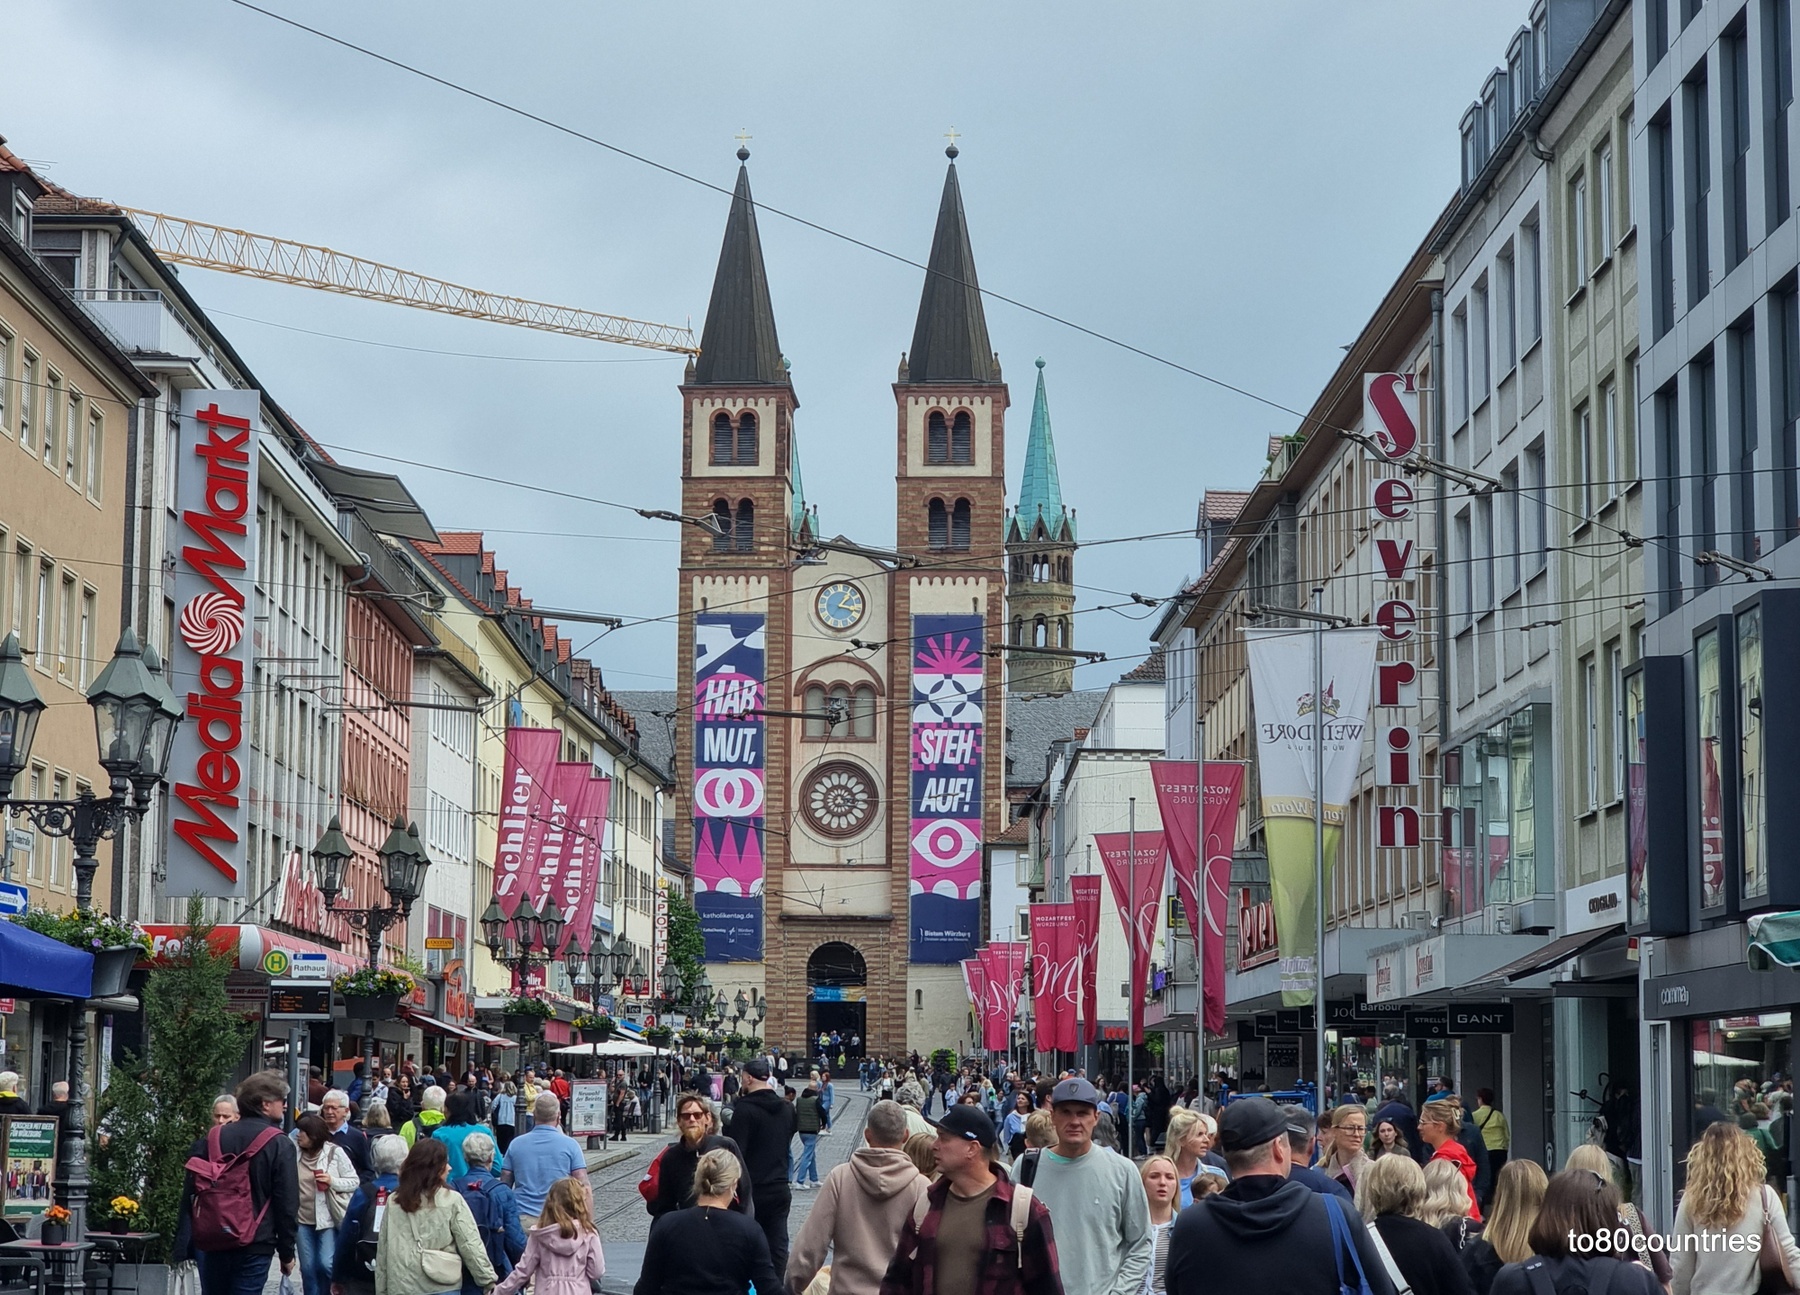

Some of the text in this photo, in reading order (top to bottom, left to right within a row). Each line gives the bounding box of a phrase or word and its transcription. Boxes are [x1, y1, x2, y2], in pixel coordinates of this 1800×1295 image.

[1369, 373, 1420, 847] Severin
[703, 679, 757, 715] HAB
[703, 727, 757, 765] MUT,
[920, 728, 975, 765] STEH
[919, 777, 975, 813] AUF!
[496, 767, 532, 896] Schlier
[526, 834, 538, 862] SEIT
[702, 912, 754, 920] katholikentag.de
[293, 964, 326, 972] Rathaus
[628, 1005, 640, 1013] Tee
[1457, 1013, 1504, 1024] GANT
